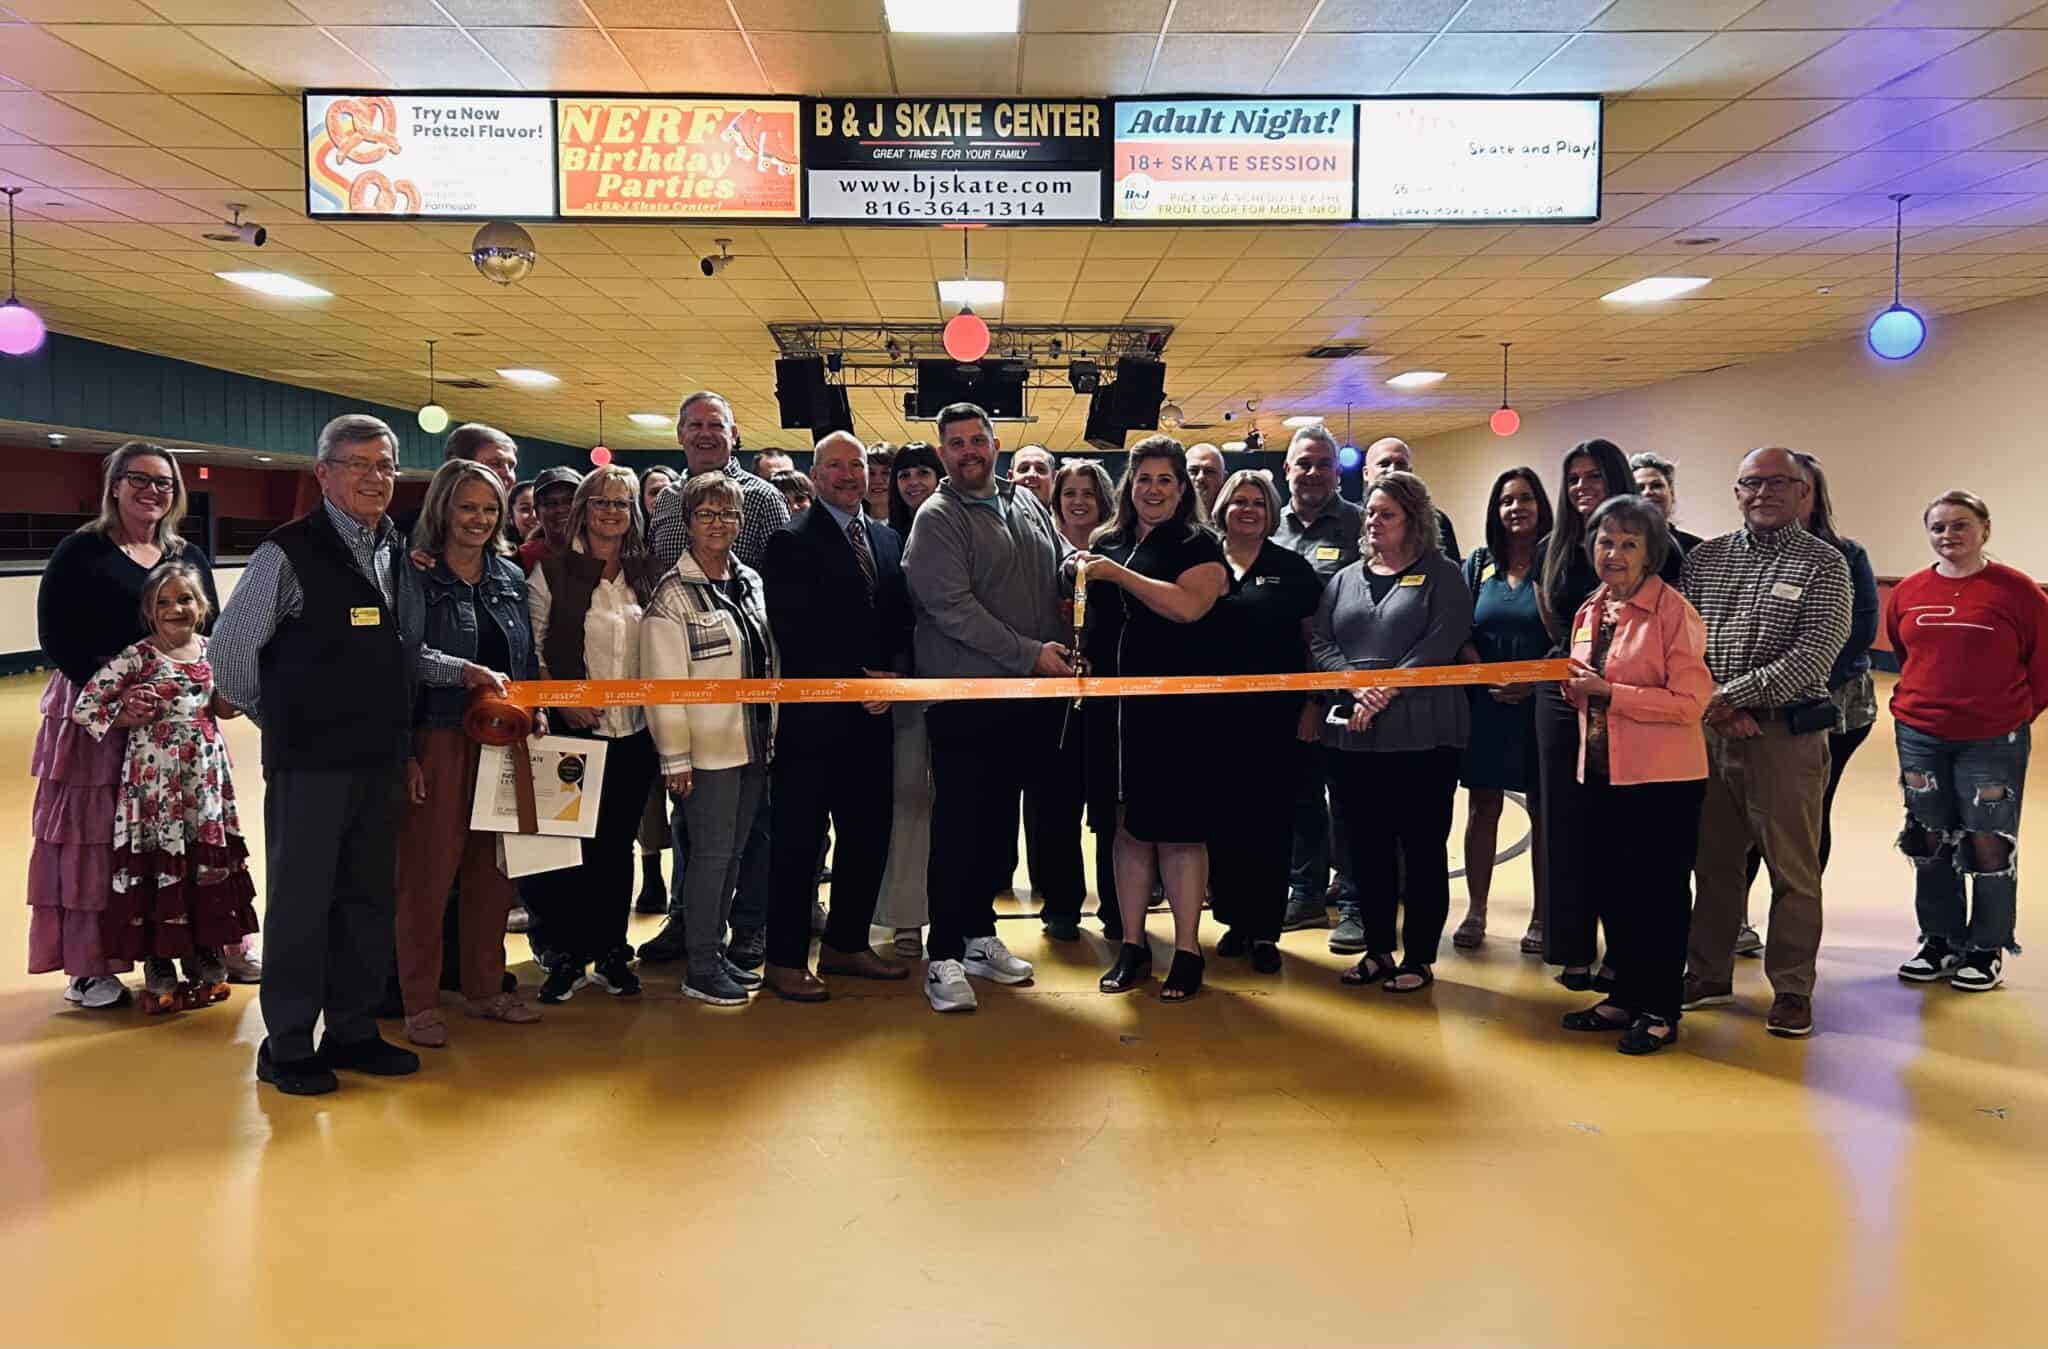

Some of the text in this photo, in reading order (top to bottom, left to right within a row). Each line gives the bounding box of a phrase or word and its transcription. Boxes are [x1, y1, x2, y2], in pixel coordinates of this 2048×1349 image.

[411, 106, 500, 124] Try a New
[560, 105, 726, 144] NERF
[815, 102, 1100, 137] B & J SKATE CENTER
[1127, 107, 1341, 140] Adult Night!
[412, 124, 543, 138] Pretzel Flavor!
[873, 149, 1027, 160] GREAT TIMES FOR YOUR FAMILY
[1468, 140, 1598, 159] Skate and Play!
[561, 145, 732, 177] Birthday
[1129, 155, 1337, 171] 18+ SKATE SESSION
[595, 173, 737, 198] Parties
[839, 174, 1073, 200] www.bjskate.com
[864, 201, 1046, 217] 816-364-1314
